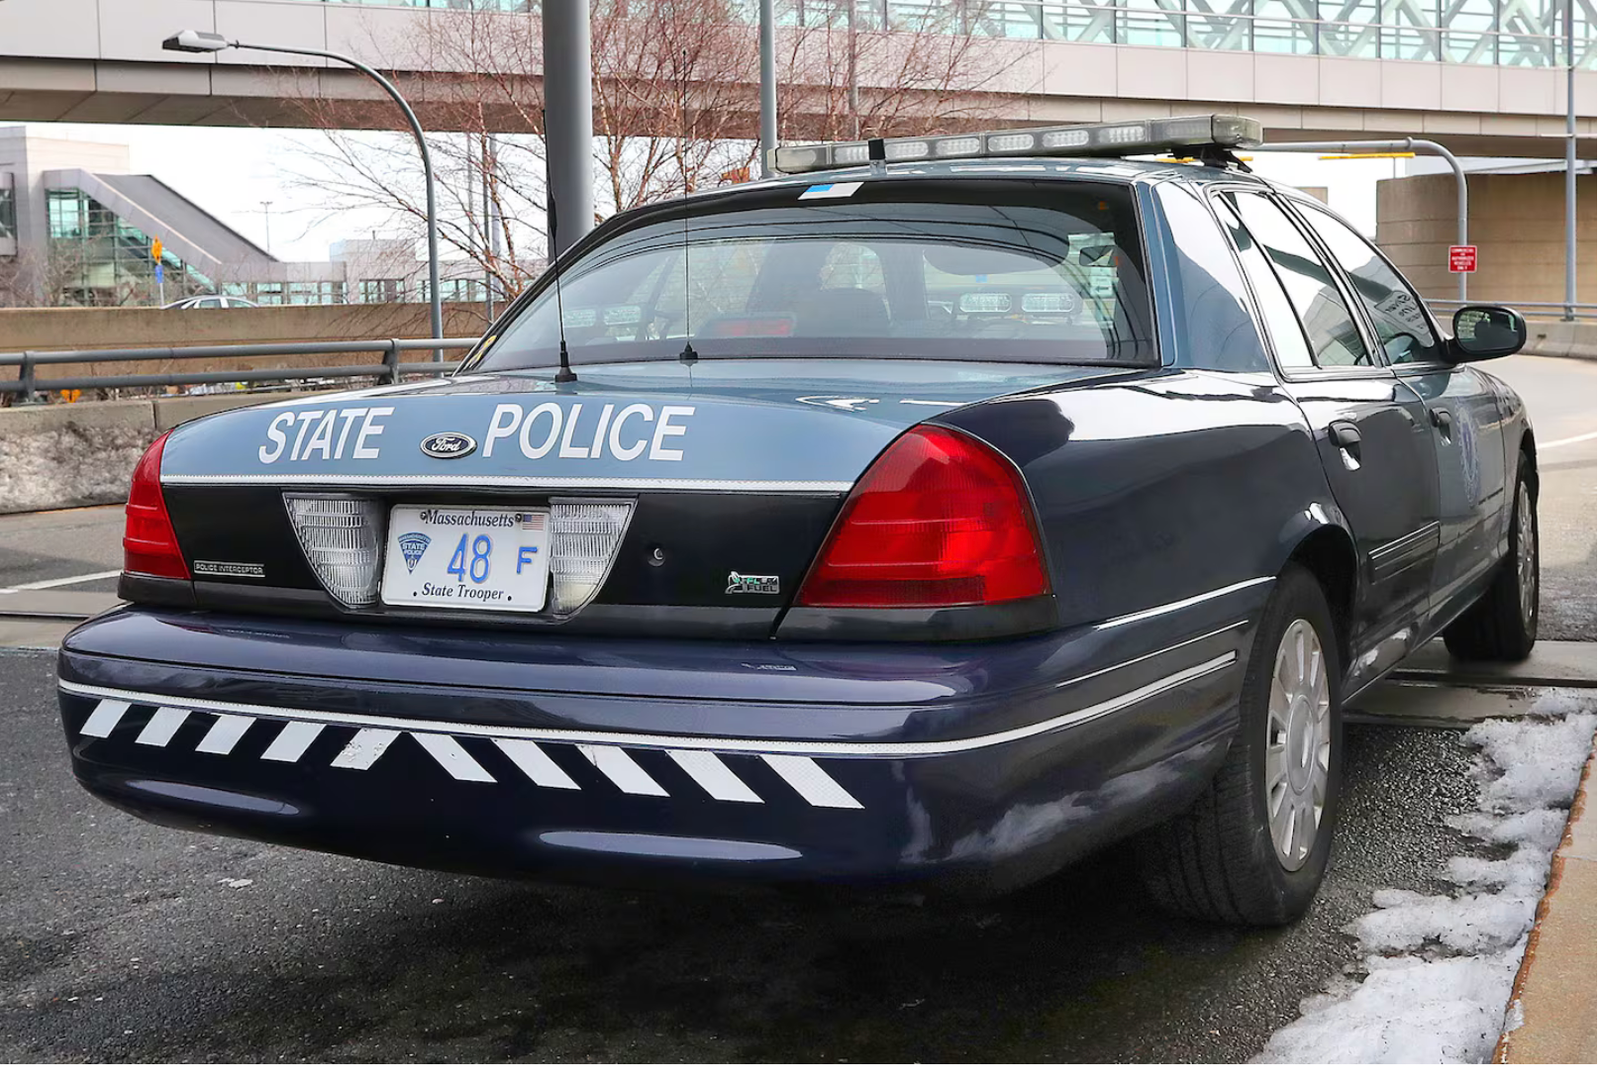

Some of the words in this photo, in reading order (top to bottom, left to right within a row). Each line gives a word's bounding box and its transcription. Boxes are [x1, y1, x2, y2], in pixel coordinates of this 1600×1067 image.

[258, 406, 395, 464] STATE
[482, 402, 695, 462] POLICE
[424, 509, 515, 528] Massachusetts
[402, 542, 425, 550] STATE
[447, 532, 491, 584] 48
[516, 546, 538, 575] F
[195, 563, 218, 572] POLICE
[219, 565, 264, 575] INTERCEPTOR
[421, 582, 454, 598] State
[457, 584, 505, 602] Trooper
